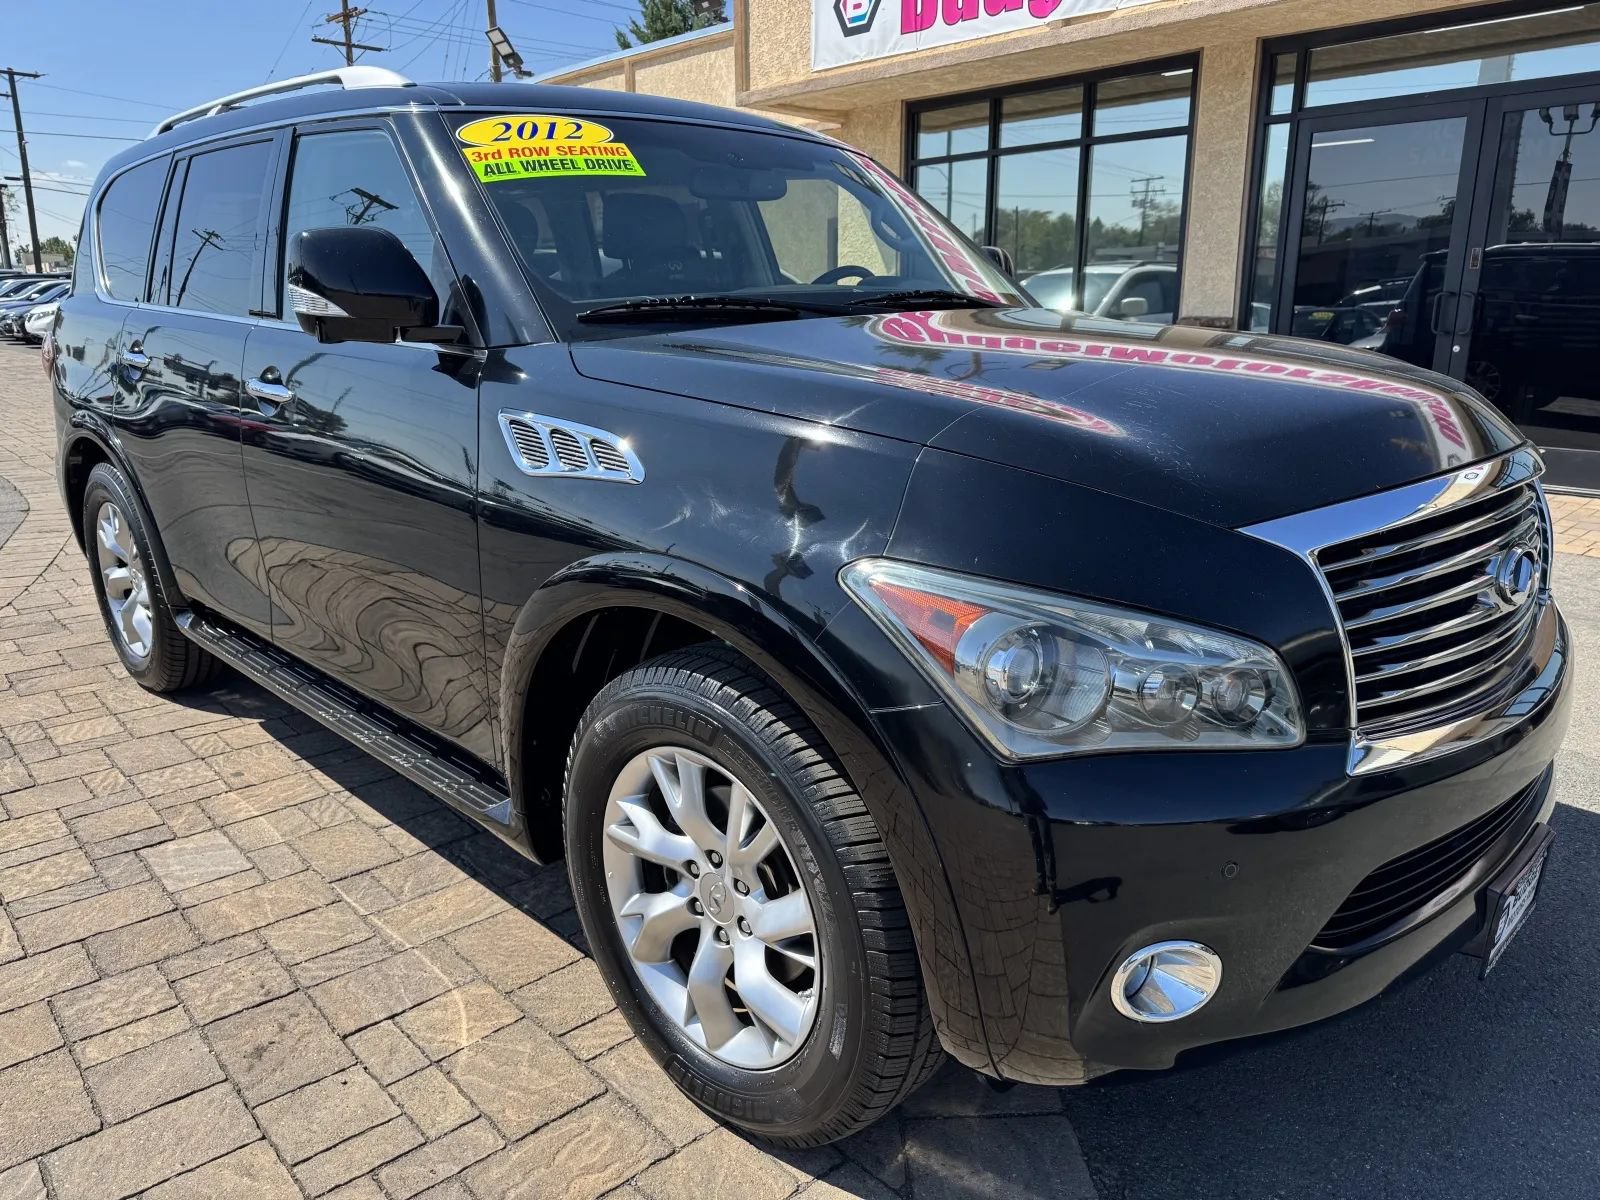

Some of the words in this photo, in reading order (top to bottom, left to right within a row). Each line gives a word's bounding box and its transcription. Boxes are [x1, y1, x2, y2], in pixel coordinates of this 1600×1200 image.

[492, 121, 583, 142] 2012
[472, 150, 502, 163] 3rd
[509, 146, 550, 159] ROW
[557, 146, 628, 157] SEATING
[483, 161, 516, 177] ALL
[521, 159, 580, 173] WHEEL
[585, 158, 634, 171] DRIVE
